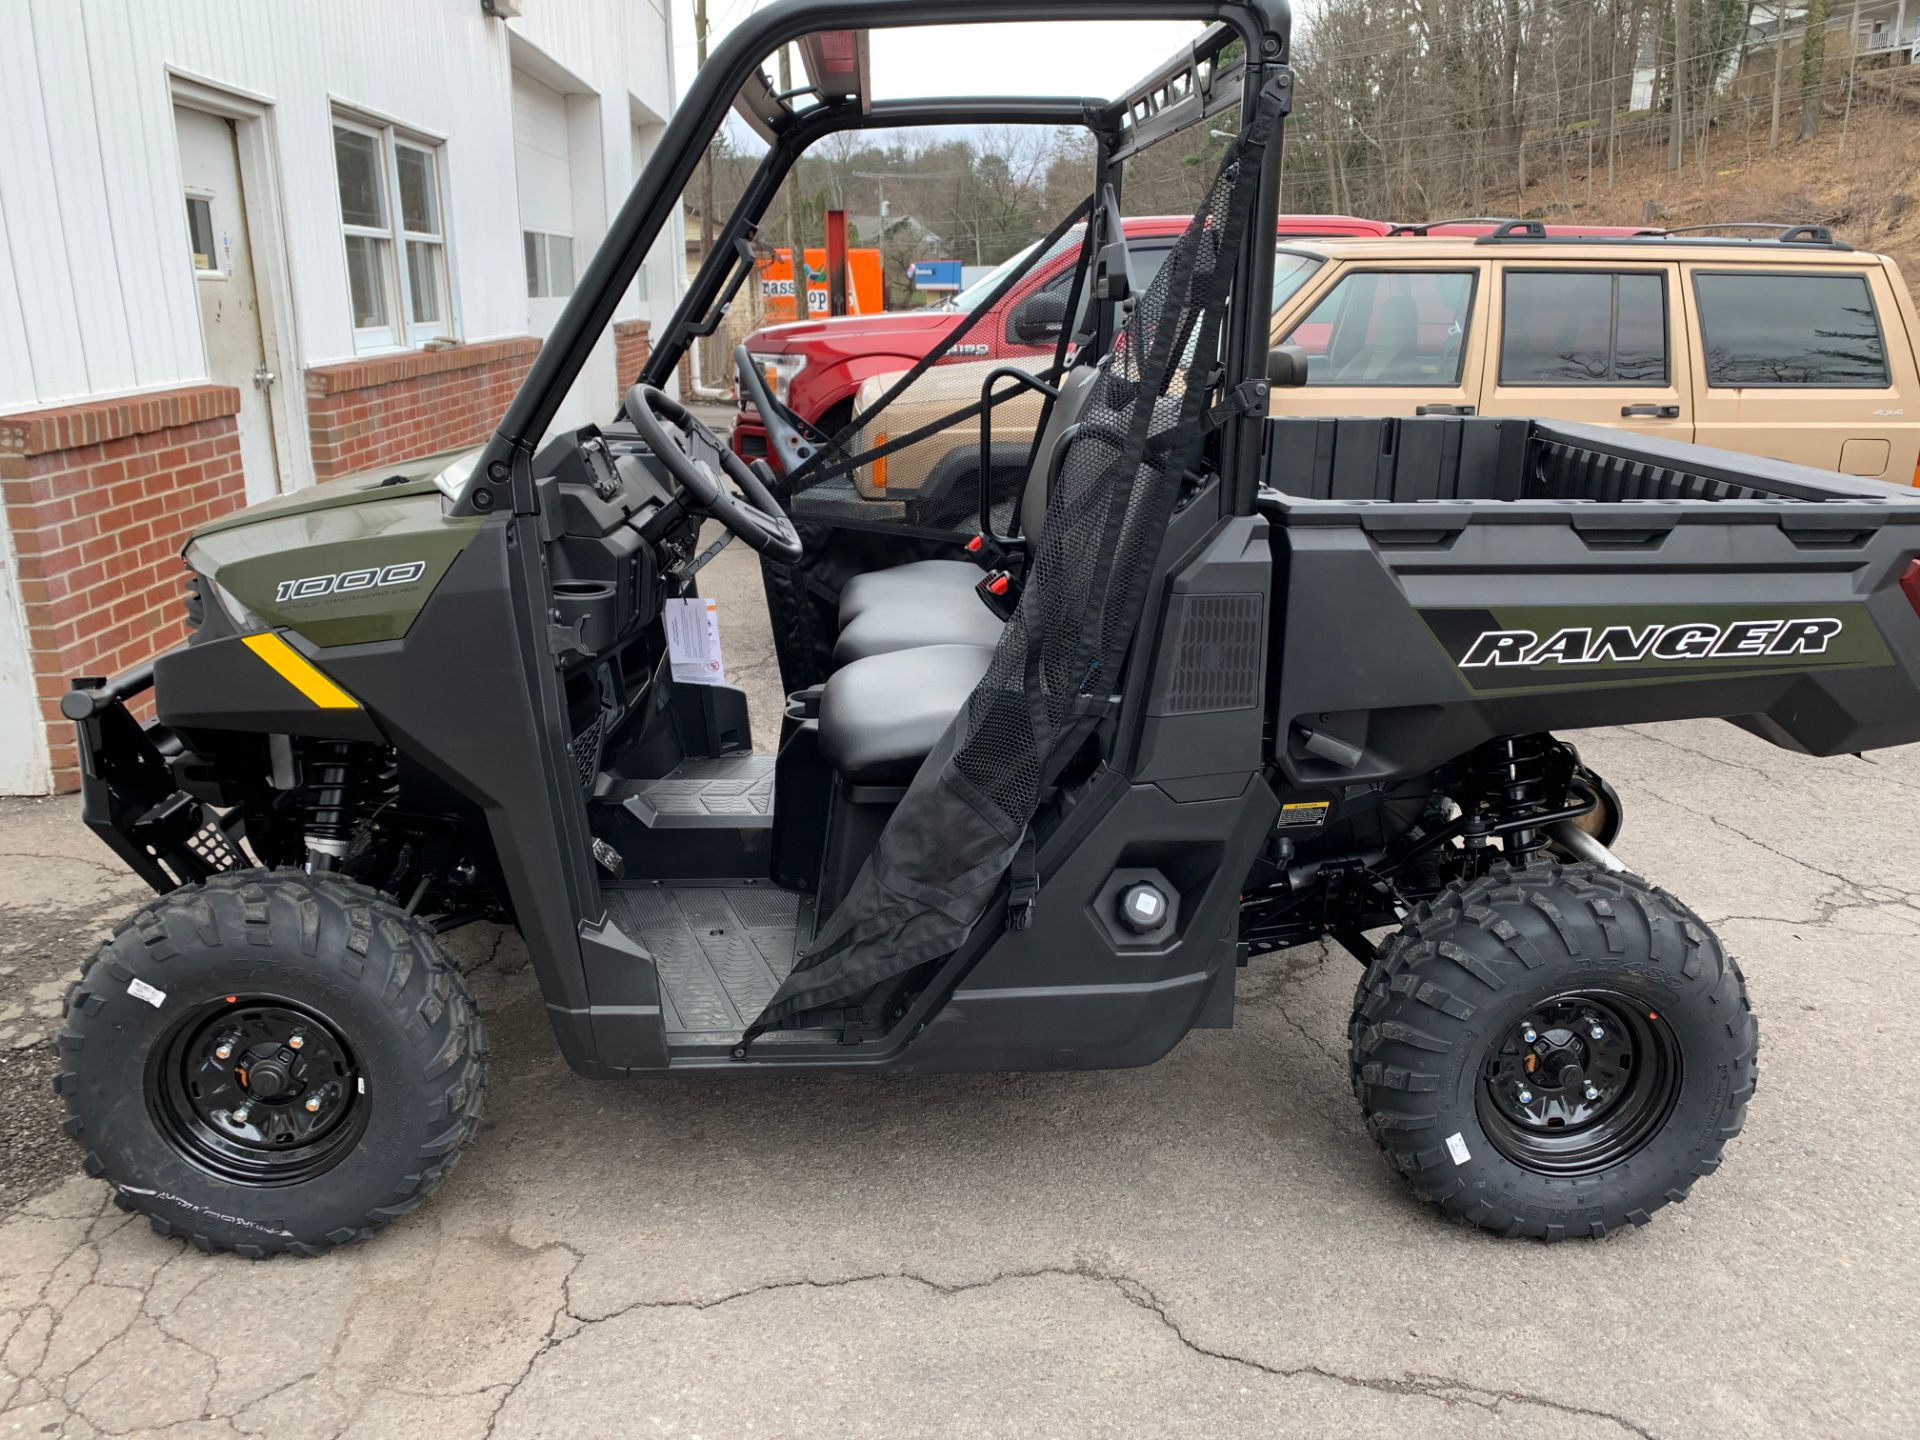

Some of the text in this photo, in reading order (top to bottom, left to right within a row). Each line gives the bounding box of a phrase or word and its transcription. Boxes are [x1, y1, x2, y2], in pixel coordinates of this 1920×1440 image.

[761, 281, 796, 295] rass
[275, 560, 426, 602] 1000
[1458, 617, 1844, 668] RANGER
